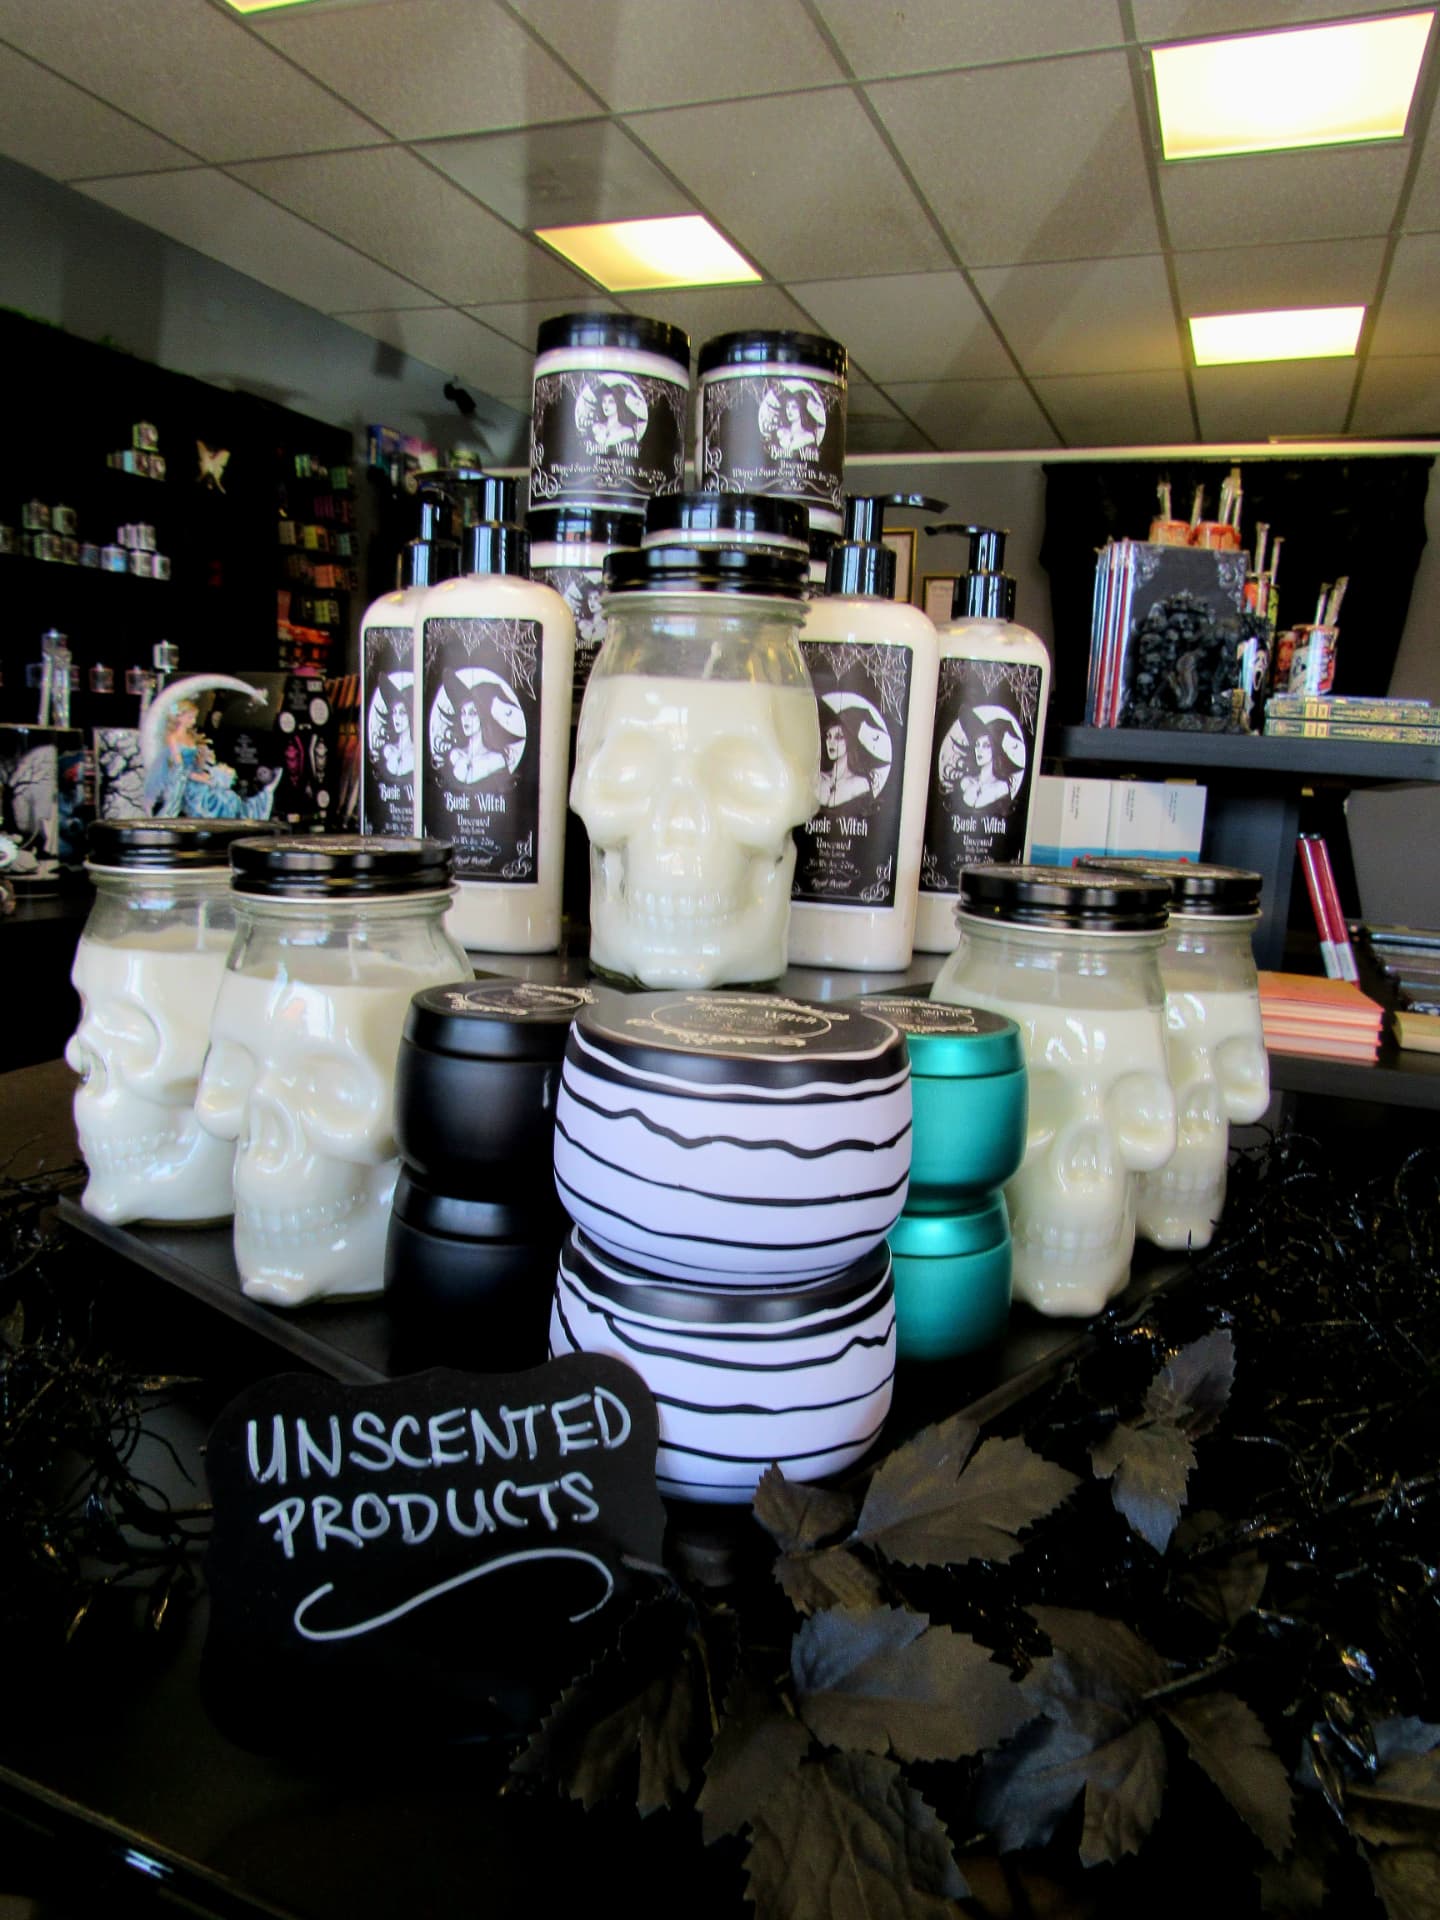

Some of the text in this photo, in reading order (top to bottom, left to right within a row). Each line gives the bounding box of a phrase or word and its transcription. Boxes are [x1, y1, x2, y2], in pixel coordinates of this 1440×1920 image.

[443, 791, 506, 814] Basic Witch
[836, 815, 868, 837] Witch
[951, 815, 1006, 835] Basic Witch
[248, 1386, 631, 1484] UNSCENTED
[259, 1471, 600, 1559] PRODUCTS
